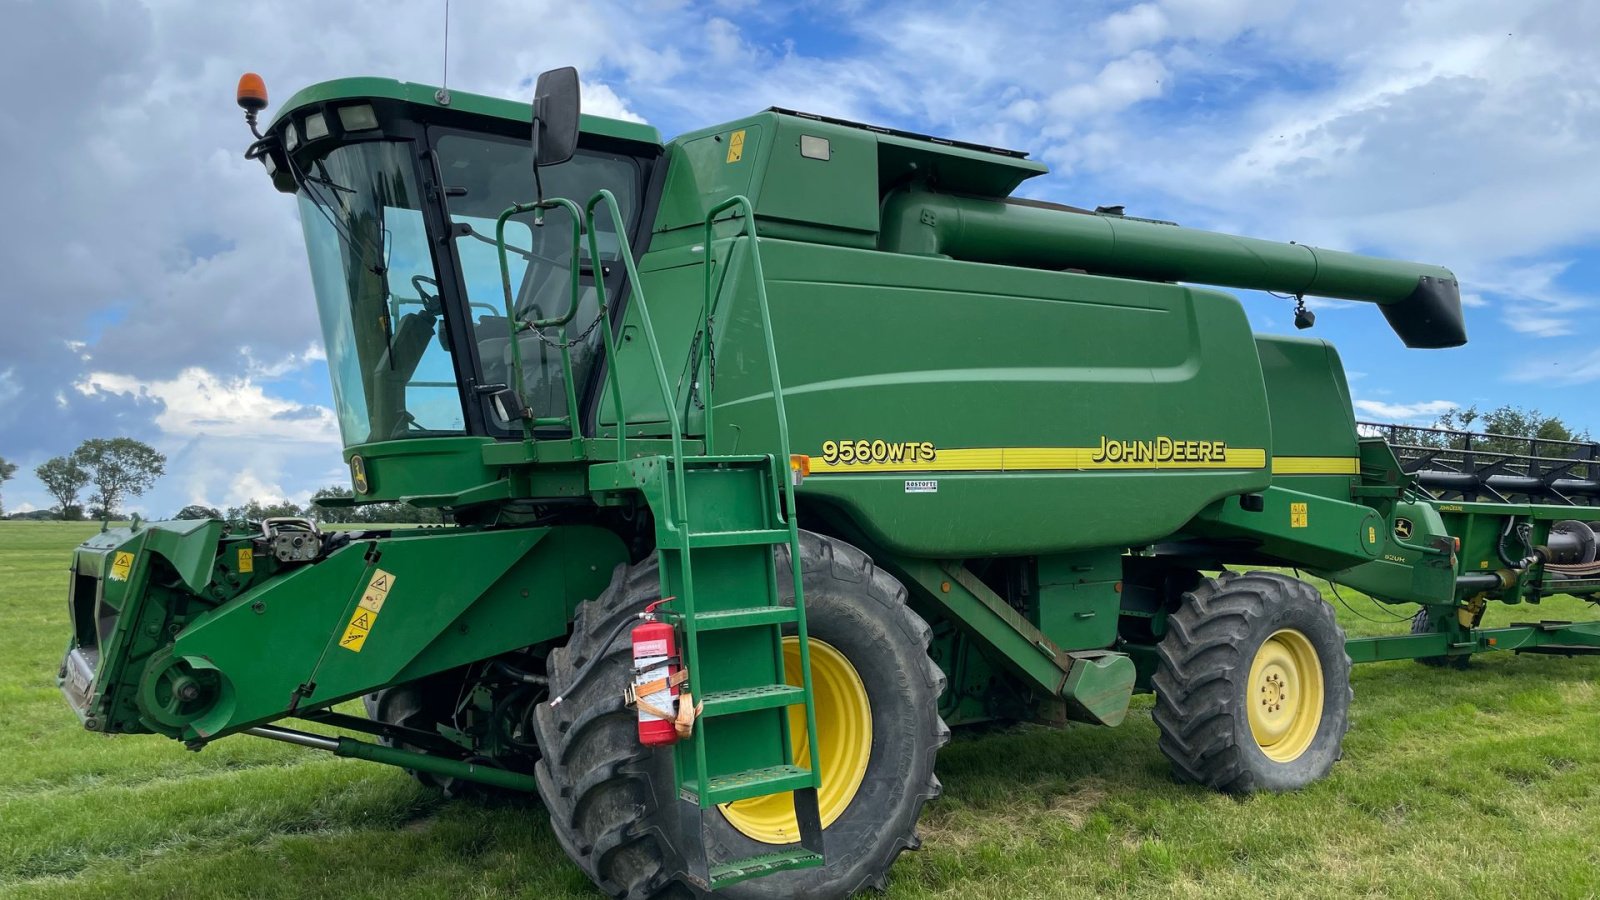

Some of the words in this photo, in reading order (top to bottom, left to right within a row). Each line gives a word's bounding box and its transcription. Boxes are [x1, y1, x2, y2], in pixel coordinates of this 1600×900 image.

[822, 439, 936, 465] 9560WTS
[1092, 435, 1154, 462] JOHN
[1156, 436, 1226, 462] DEERE
